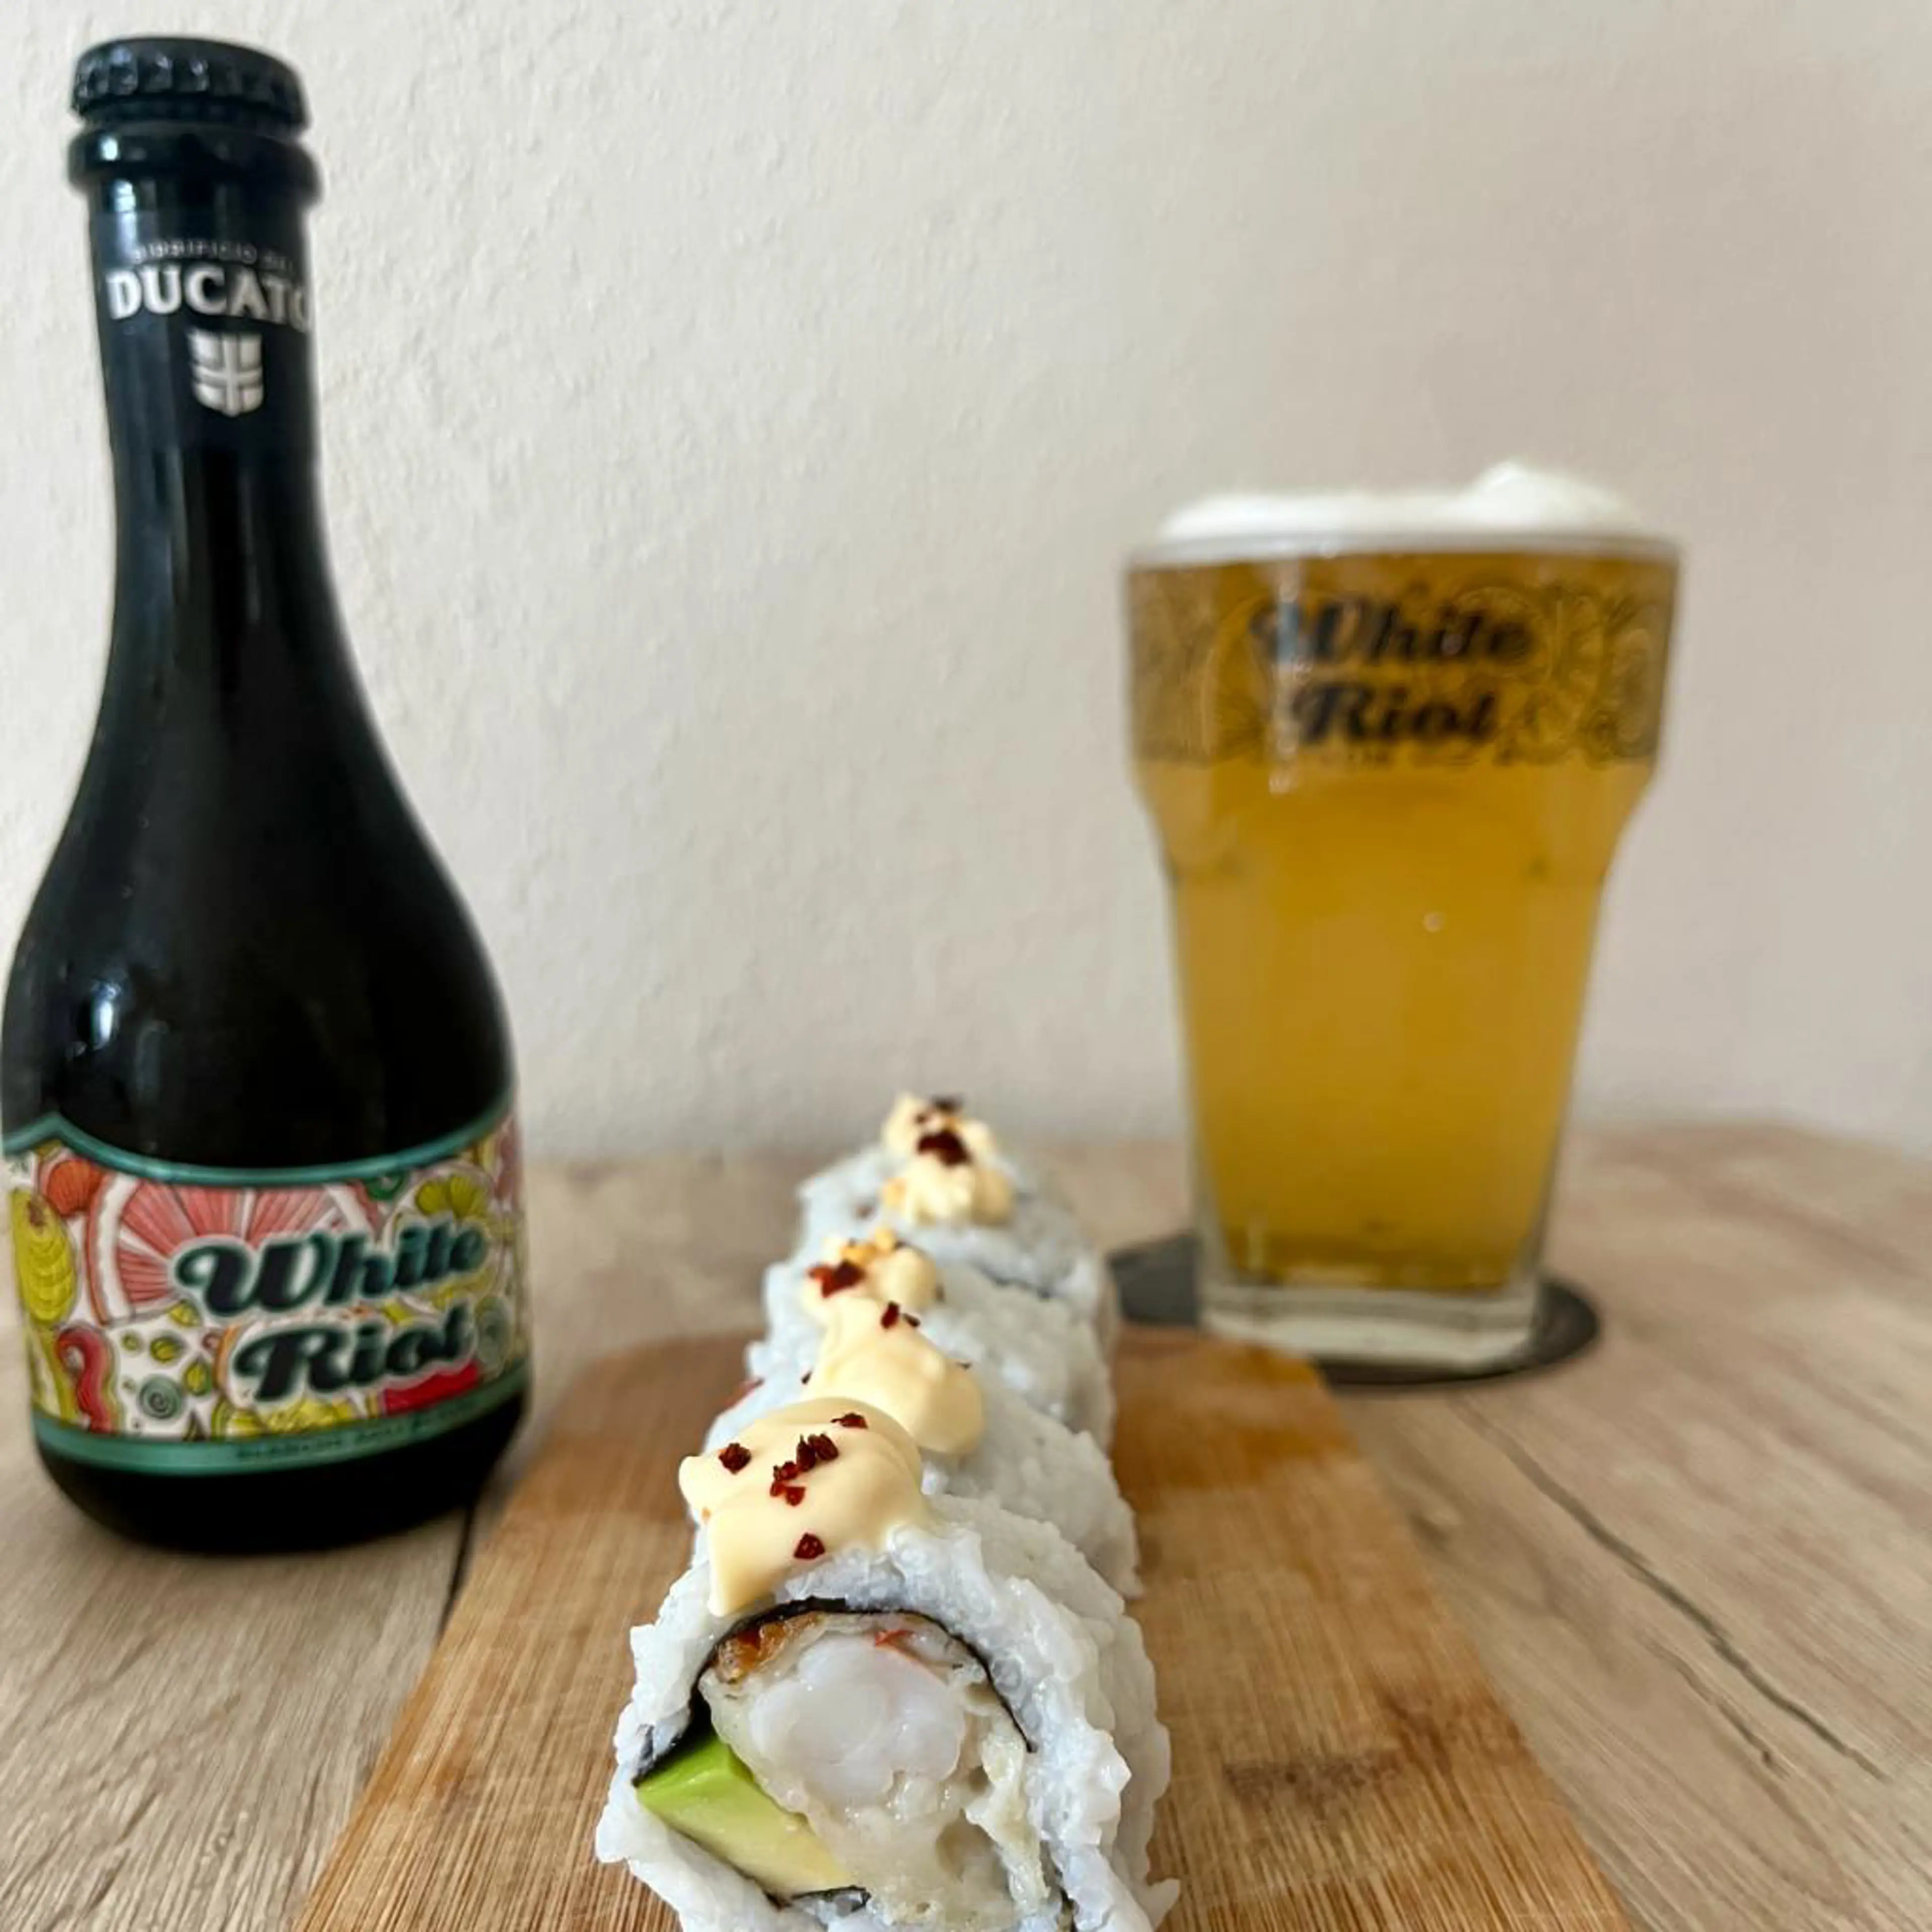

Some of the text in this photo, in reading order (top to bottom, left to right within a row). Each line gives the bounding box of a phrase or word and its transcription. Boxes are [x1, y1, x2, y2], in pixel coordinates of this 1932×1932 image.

[1248, 598, 1534, 666] White
[1290, 679, 1498, 747] Riot
[174, 1221, 488, 1317] White
[233, 1301, 469, 1402] Riot
